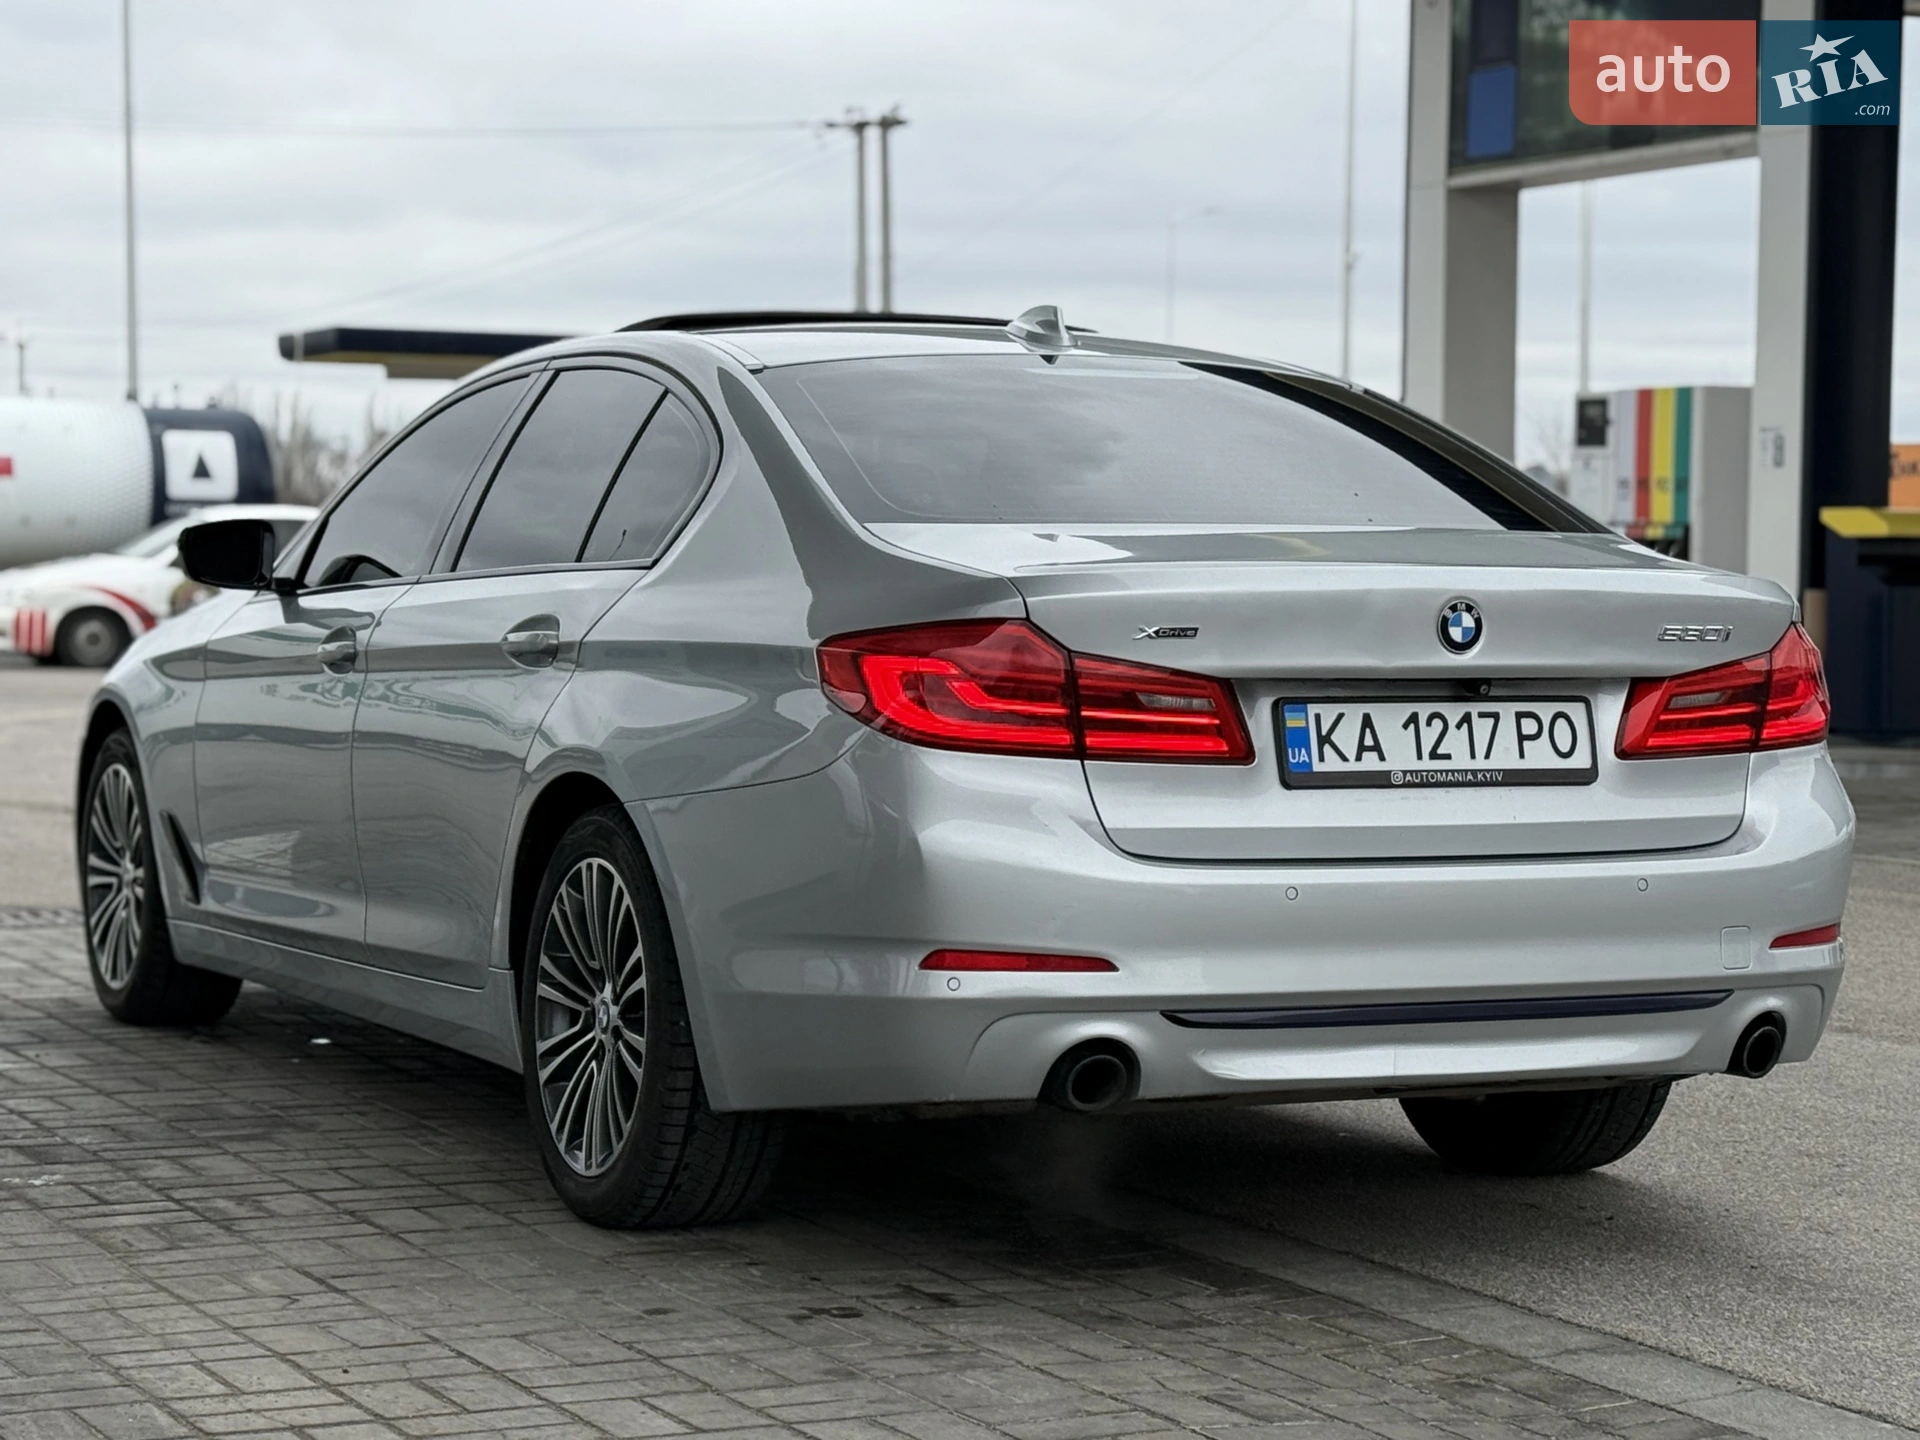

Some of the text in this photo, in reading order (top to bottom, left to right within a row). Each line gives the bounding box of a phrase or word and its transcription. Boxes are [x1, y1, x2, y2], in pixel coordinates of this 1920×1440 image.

[1314, 711, 1578, 763] KA 1217 PO
[1288, 747, 1309, 763] UA
[1405, 771, 1504, 783] AUTOMANIA.KYIV
